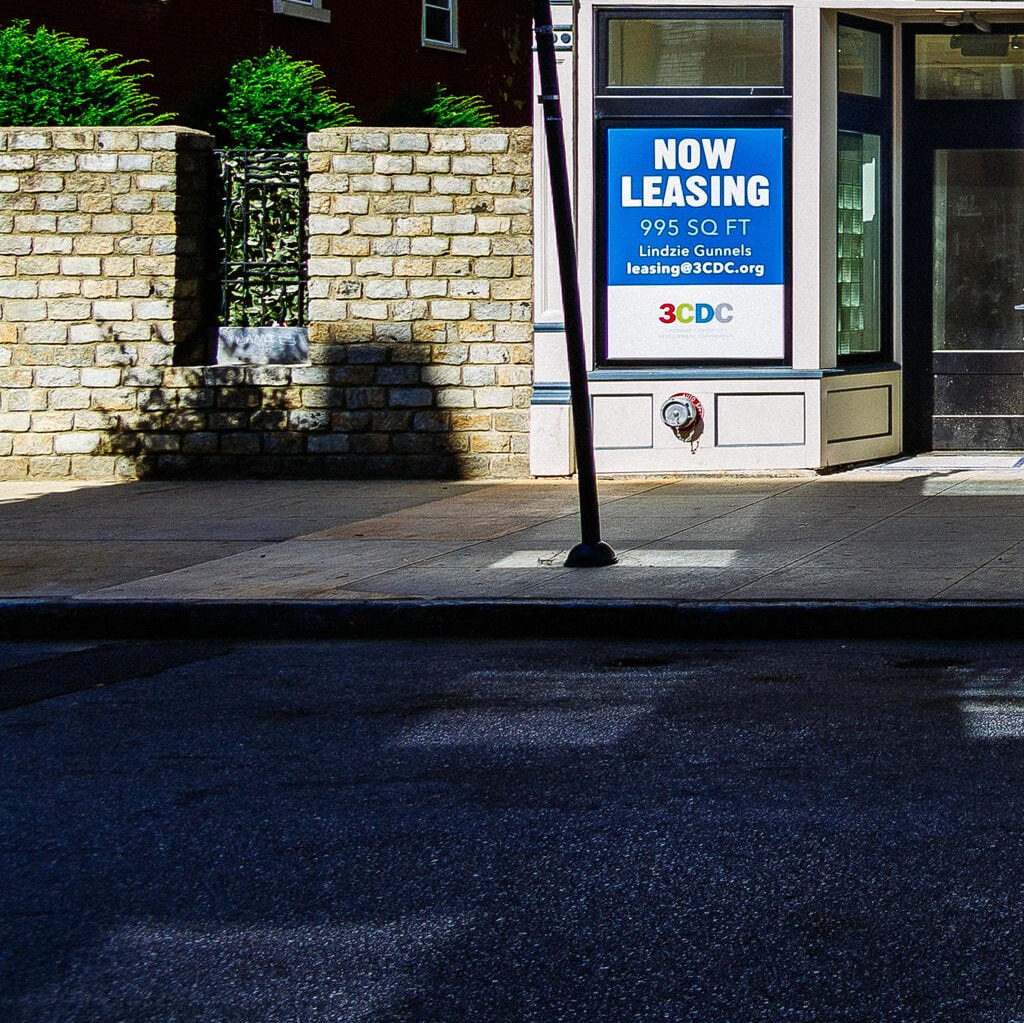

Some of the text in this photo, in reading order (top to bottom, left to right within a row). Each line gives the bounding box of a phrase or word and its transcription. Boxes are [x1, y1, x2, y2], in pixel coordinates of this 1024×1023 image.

[654, 138, 736, 170] NOW
[621, 175, 770, 207] LEASING
[640, 219, 751, 236] 995 SQ FT
[639, 244, 752, 257] Lindzie Gunnels
[627, 261, 765, 277] leasing@3CDC.org
[658, 303, 734, 324] 3CDC
